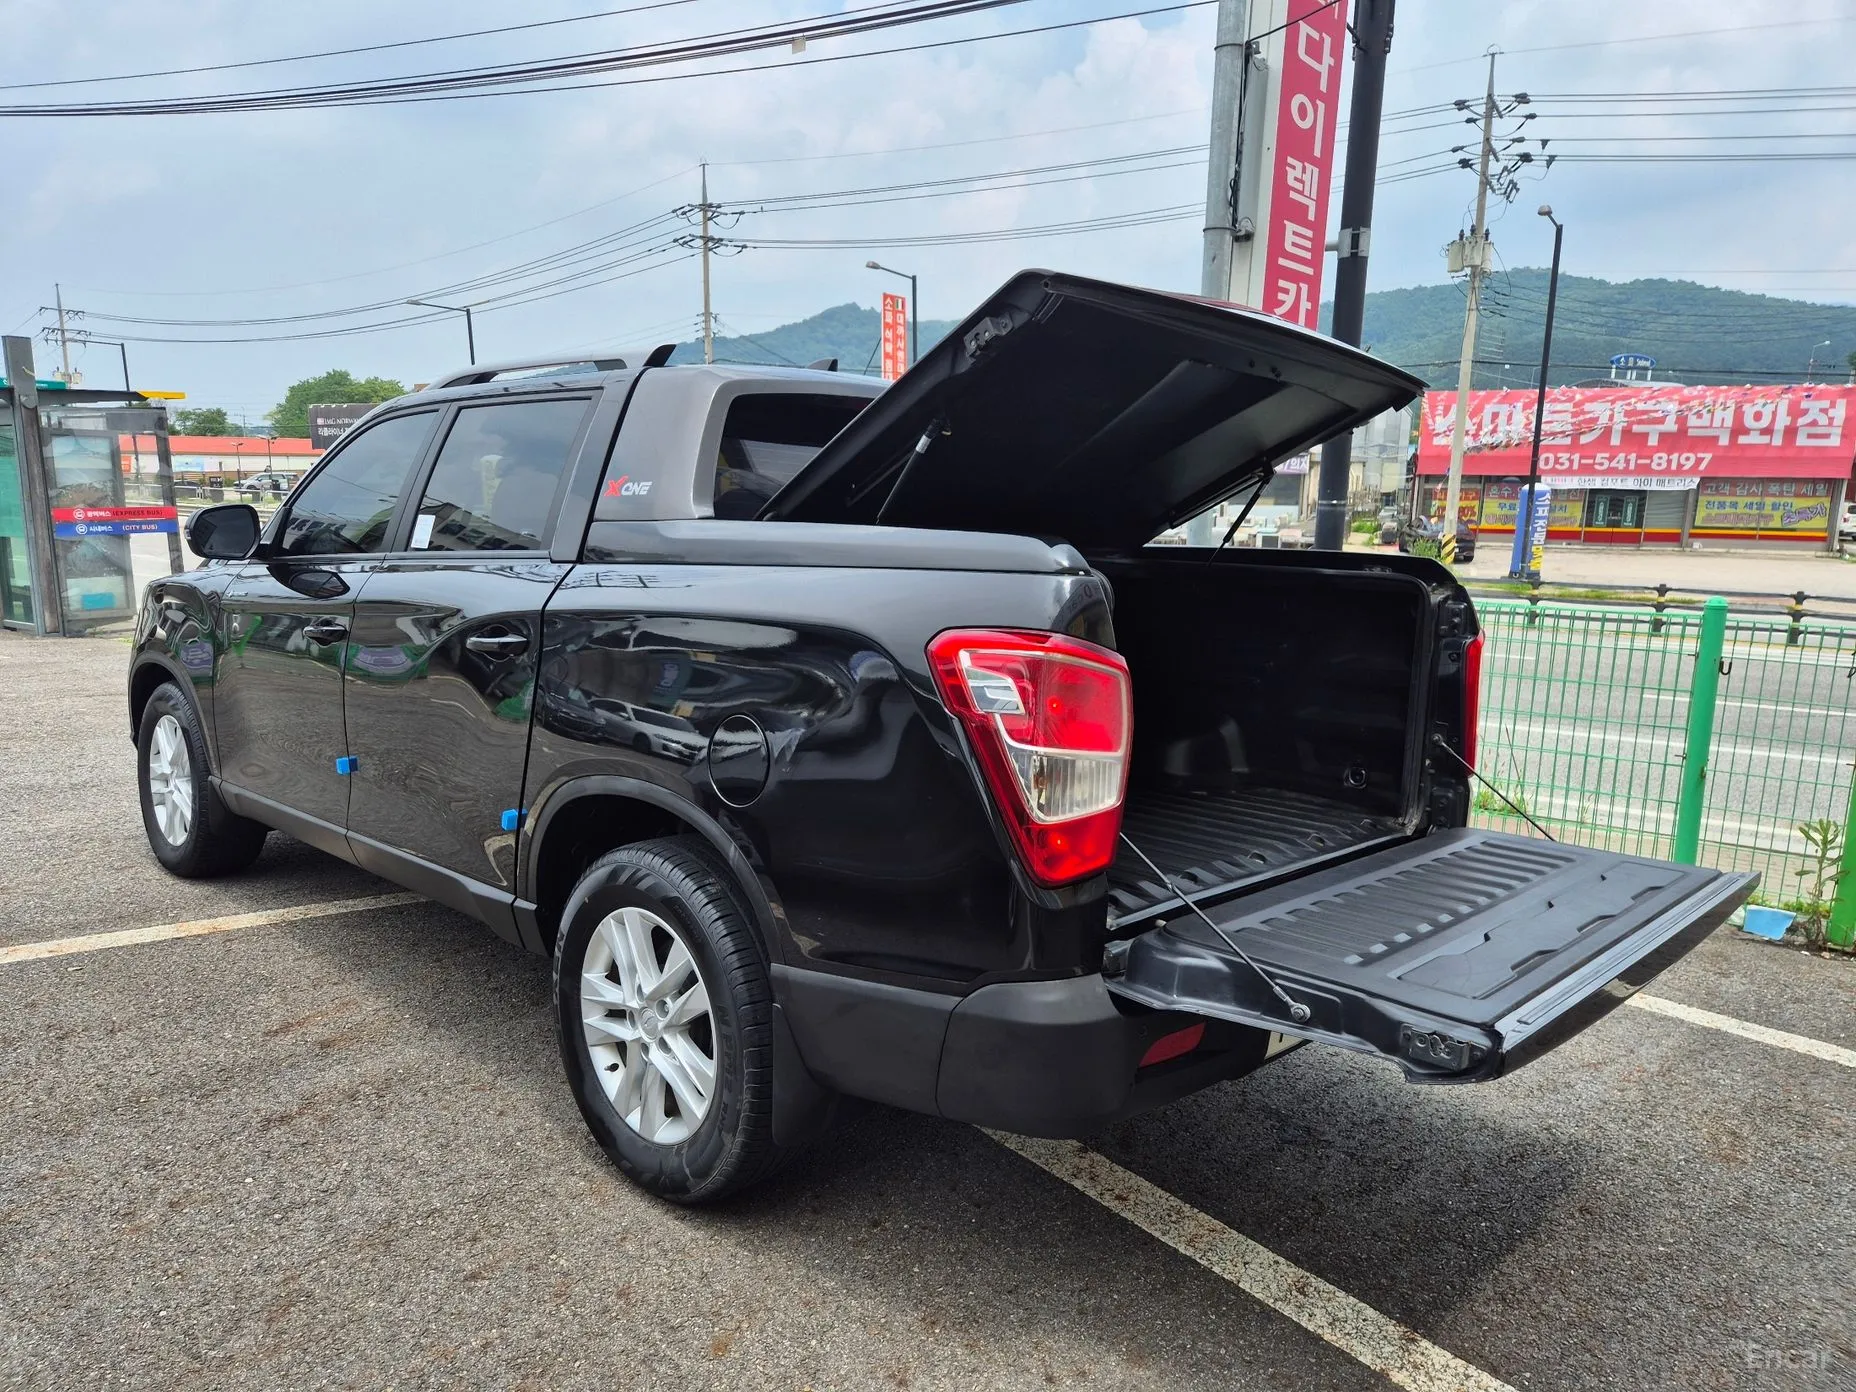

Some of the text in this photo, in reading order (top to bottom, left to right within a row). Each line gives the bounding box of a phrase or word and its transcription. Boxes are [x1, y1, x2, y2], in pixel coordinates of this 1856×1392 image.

[1538, 452, 1712, 471] 031-541-8197
[1656, 477, 1695, 487] 매트리스
[1703, 482, 1828, 497] 고객 감사 폭탄 세일
[113, 509, 145, 517] (EXPRESS
